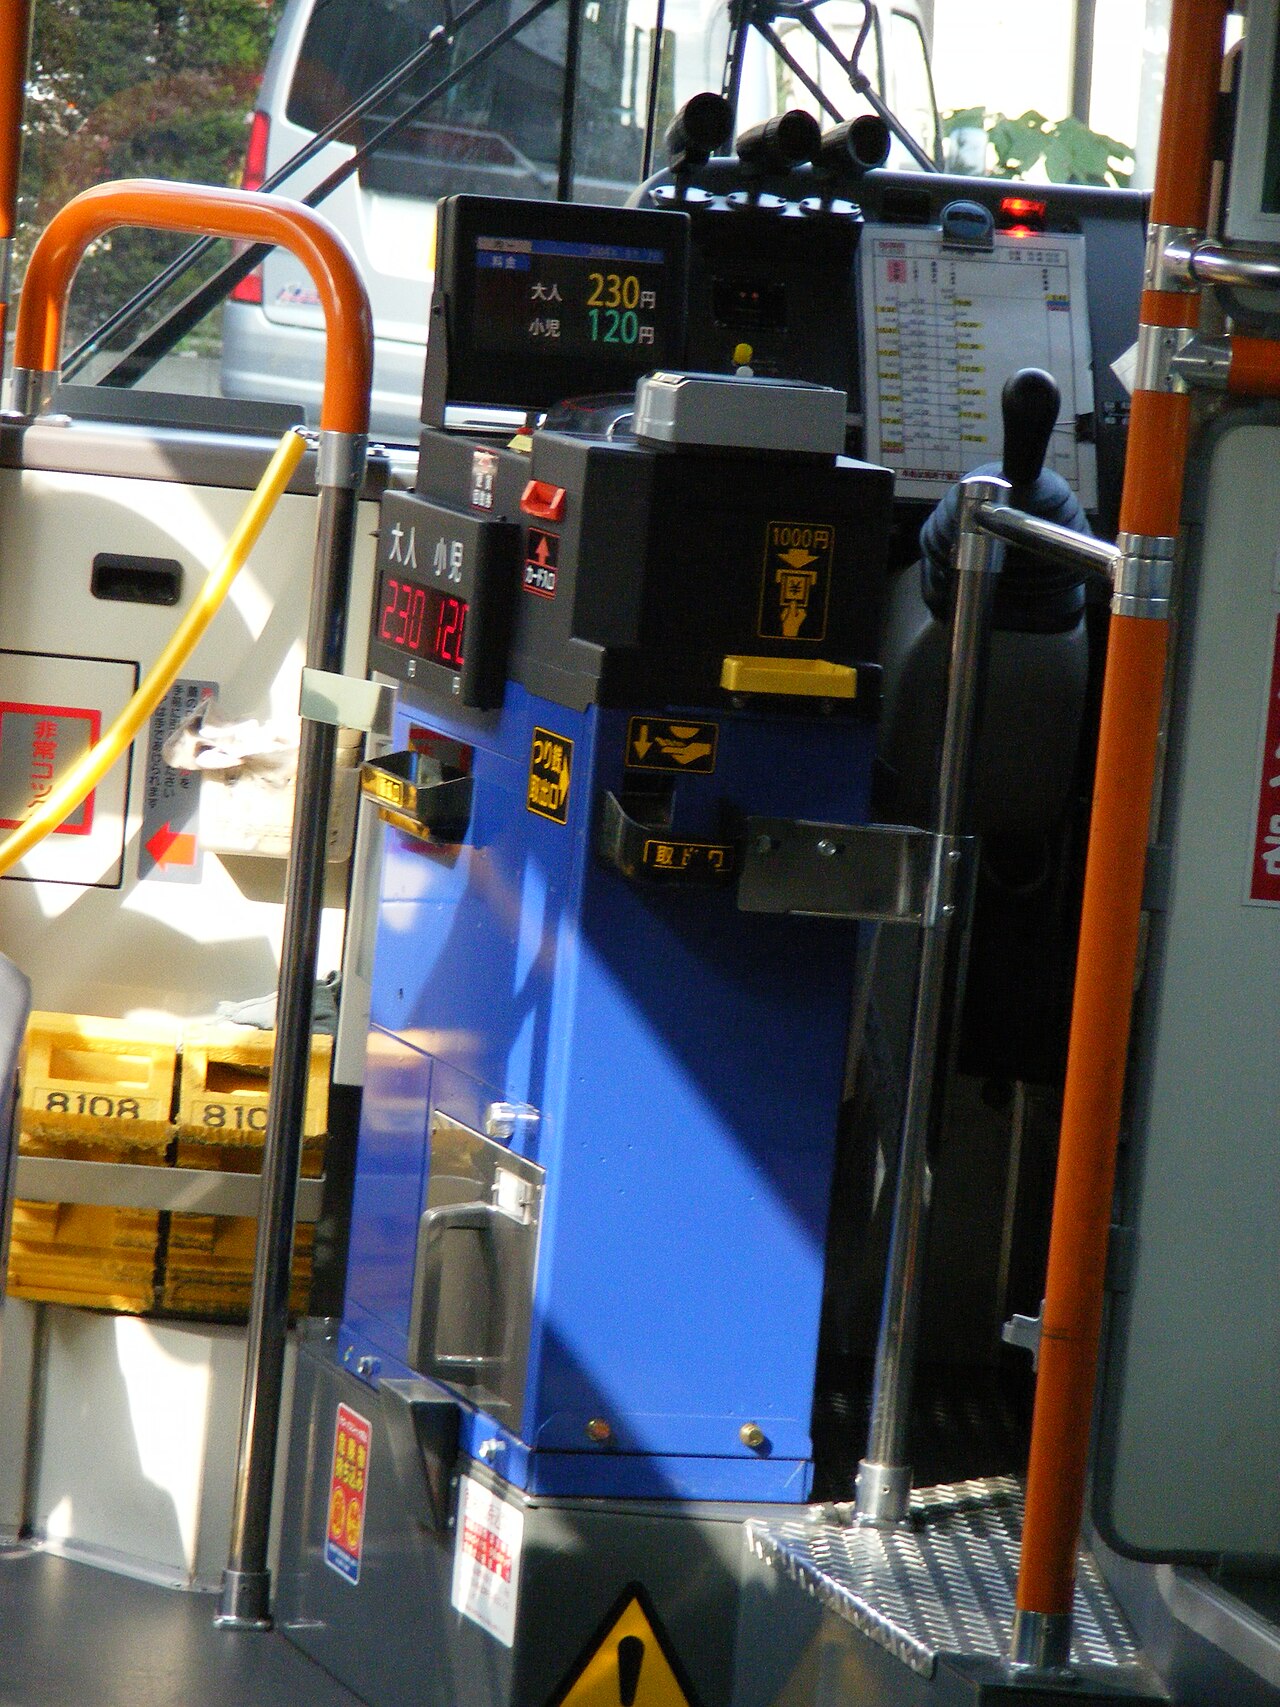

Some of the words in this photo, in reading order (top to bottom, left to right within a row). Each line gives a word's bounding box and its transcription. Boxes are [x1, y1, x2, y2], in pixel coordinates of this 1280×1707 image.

[530, 282, 563, 302] 大人
[528, 317, 561, 338] 小児
[772, 527, 830, 550] 1000円
[388, 522, 417, 569] 大人
[433, 537, 465, 583] 小児
[380, 579, 426, 650] 230
[45, 1091, 140, 1120] 8108
